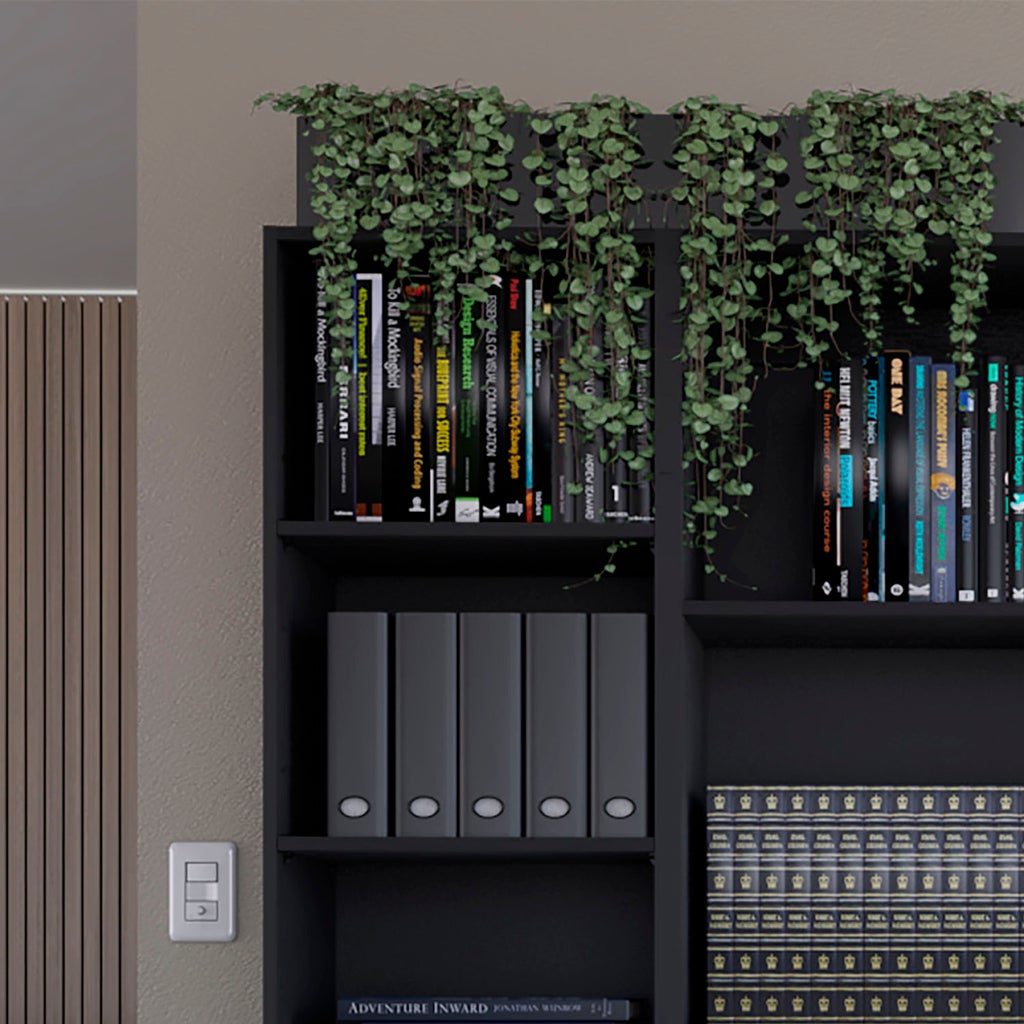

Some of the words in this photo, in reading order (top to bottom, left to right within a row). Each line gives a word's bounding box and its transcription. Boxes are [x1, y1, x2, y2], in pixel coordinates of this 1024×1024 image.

[459, 297, 475, 335] Design
[383, 327, 400, 388] Mockingbird
[462, 337, 475, 389] Research
[891, 358, 903, 385] ONE
[822, 389, 832, 411] the
[867, 380, 877, 420] POTTERY
[891, 387, 903, 415] DAY
[822, 413, 832, 460] interior
[839, 408, 851, 449] NEWTON
[867, 421, 877, 444] basics
[1015, 420, 1024, 454] Modern
[822, 463, 832, 506] design
[1013, 455, 1024, 487] Design
[822, 509, 832, 553] course
[349, 1002, 429, 1014] ADVENTURE
[434, 1002, 489, 1014] INWARD
